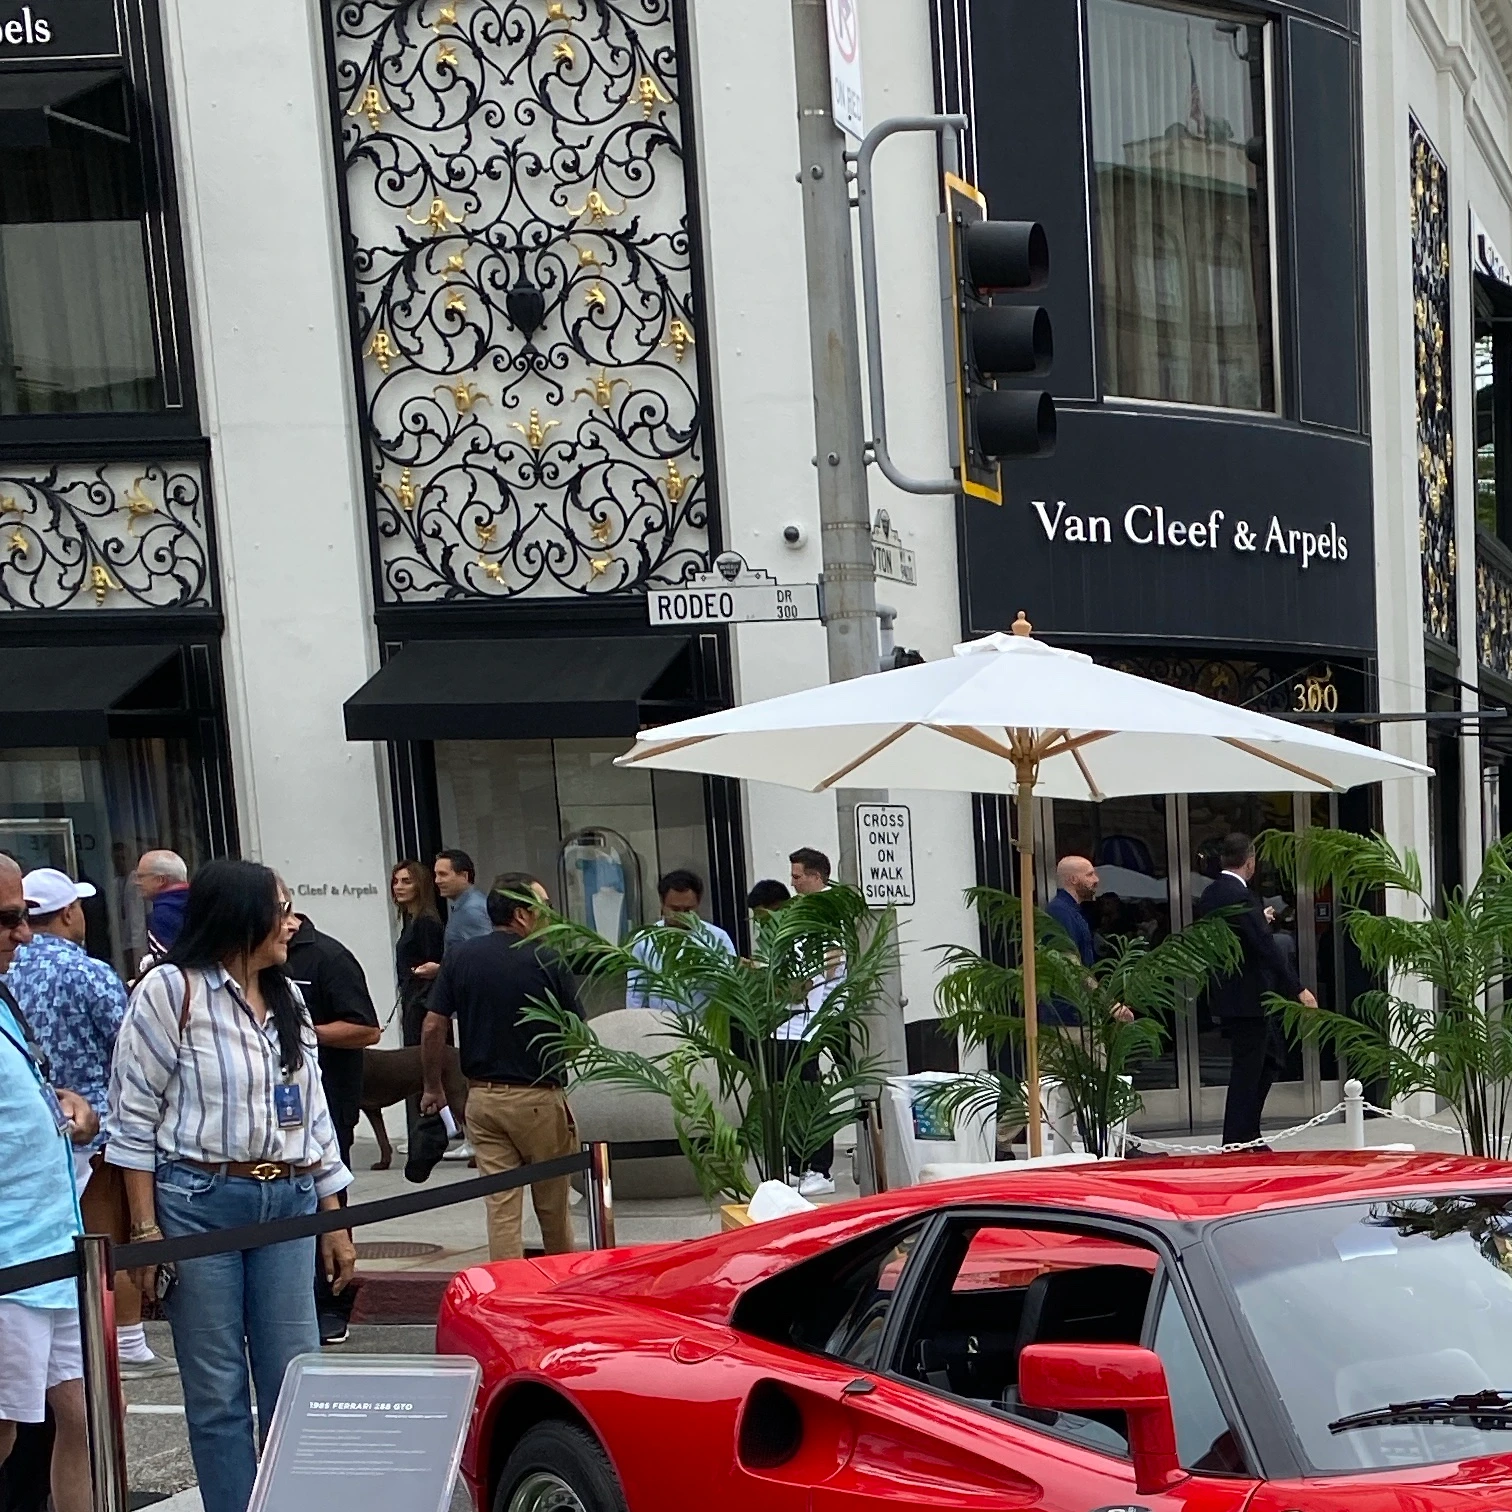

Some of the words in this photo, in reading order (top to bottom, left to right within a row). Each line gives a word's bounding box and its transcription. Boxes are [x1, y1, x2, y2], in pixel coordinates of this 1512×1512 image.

[1031, 501, 1112, 543] Van
[1124, 504, 1225, 549] Cleef
[1234, 520, 1256, 551] &
[1264, 515, 1349, 568] Arpels
[657, 592, 734, 620] RODEO
[776, 589, 793, 603] DR
[776, 605, 798, 619] 300
[1293, 683, 1338, 713] 300
[863, 813, 904, 827] CROSS
[869, 831, 899, 845] ONLY
[877, 849, 894, 862] ON
[870, 866, 903, 880] WALK
[298, 884, 327, 897] Cleef
[342, 883, 378, 899] Arpels
[866, 884, 910, 898] SIGNAL
[332, 1402, 371, 1411] FERRARI
[393, 1403, 413, 1411] GTO
